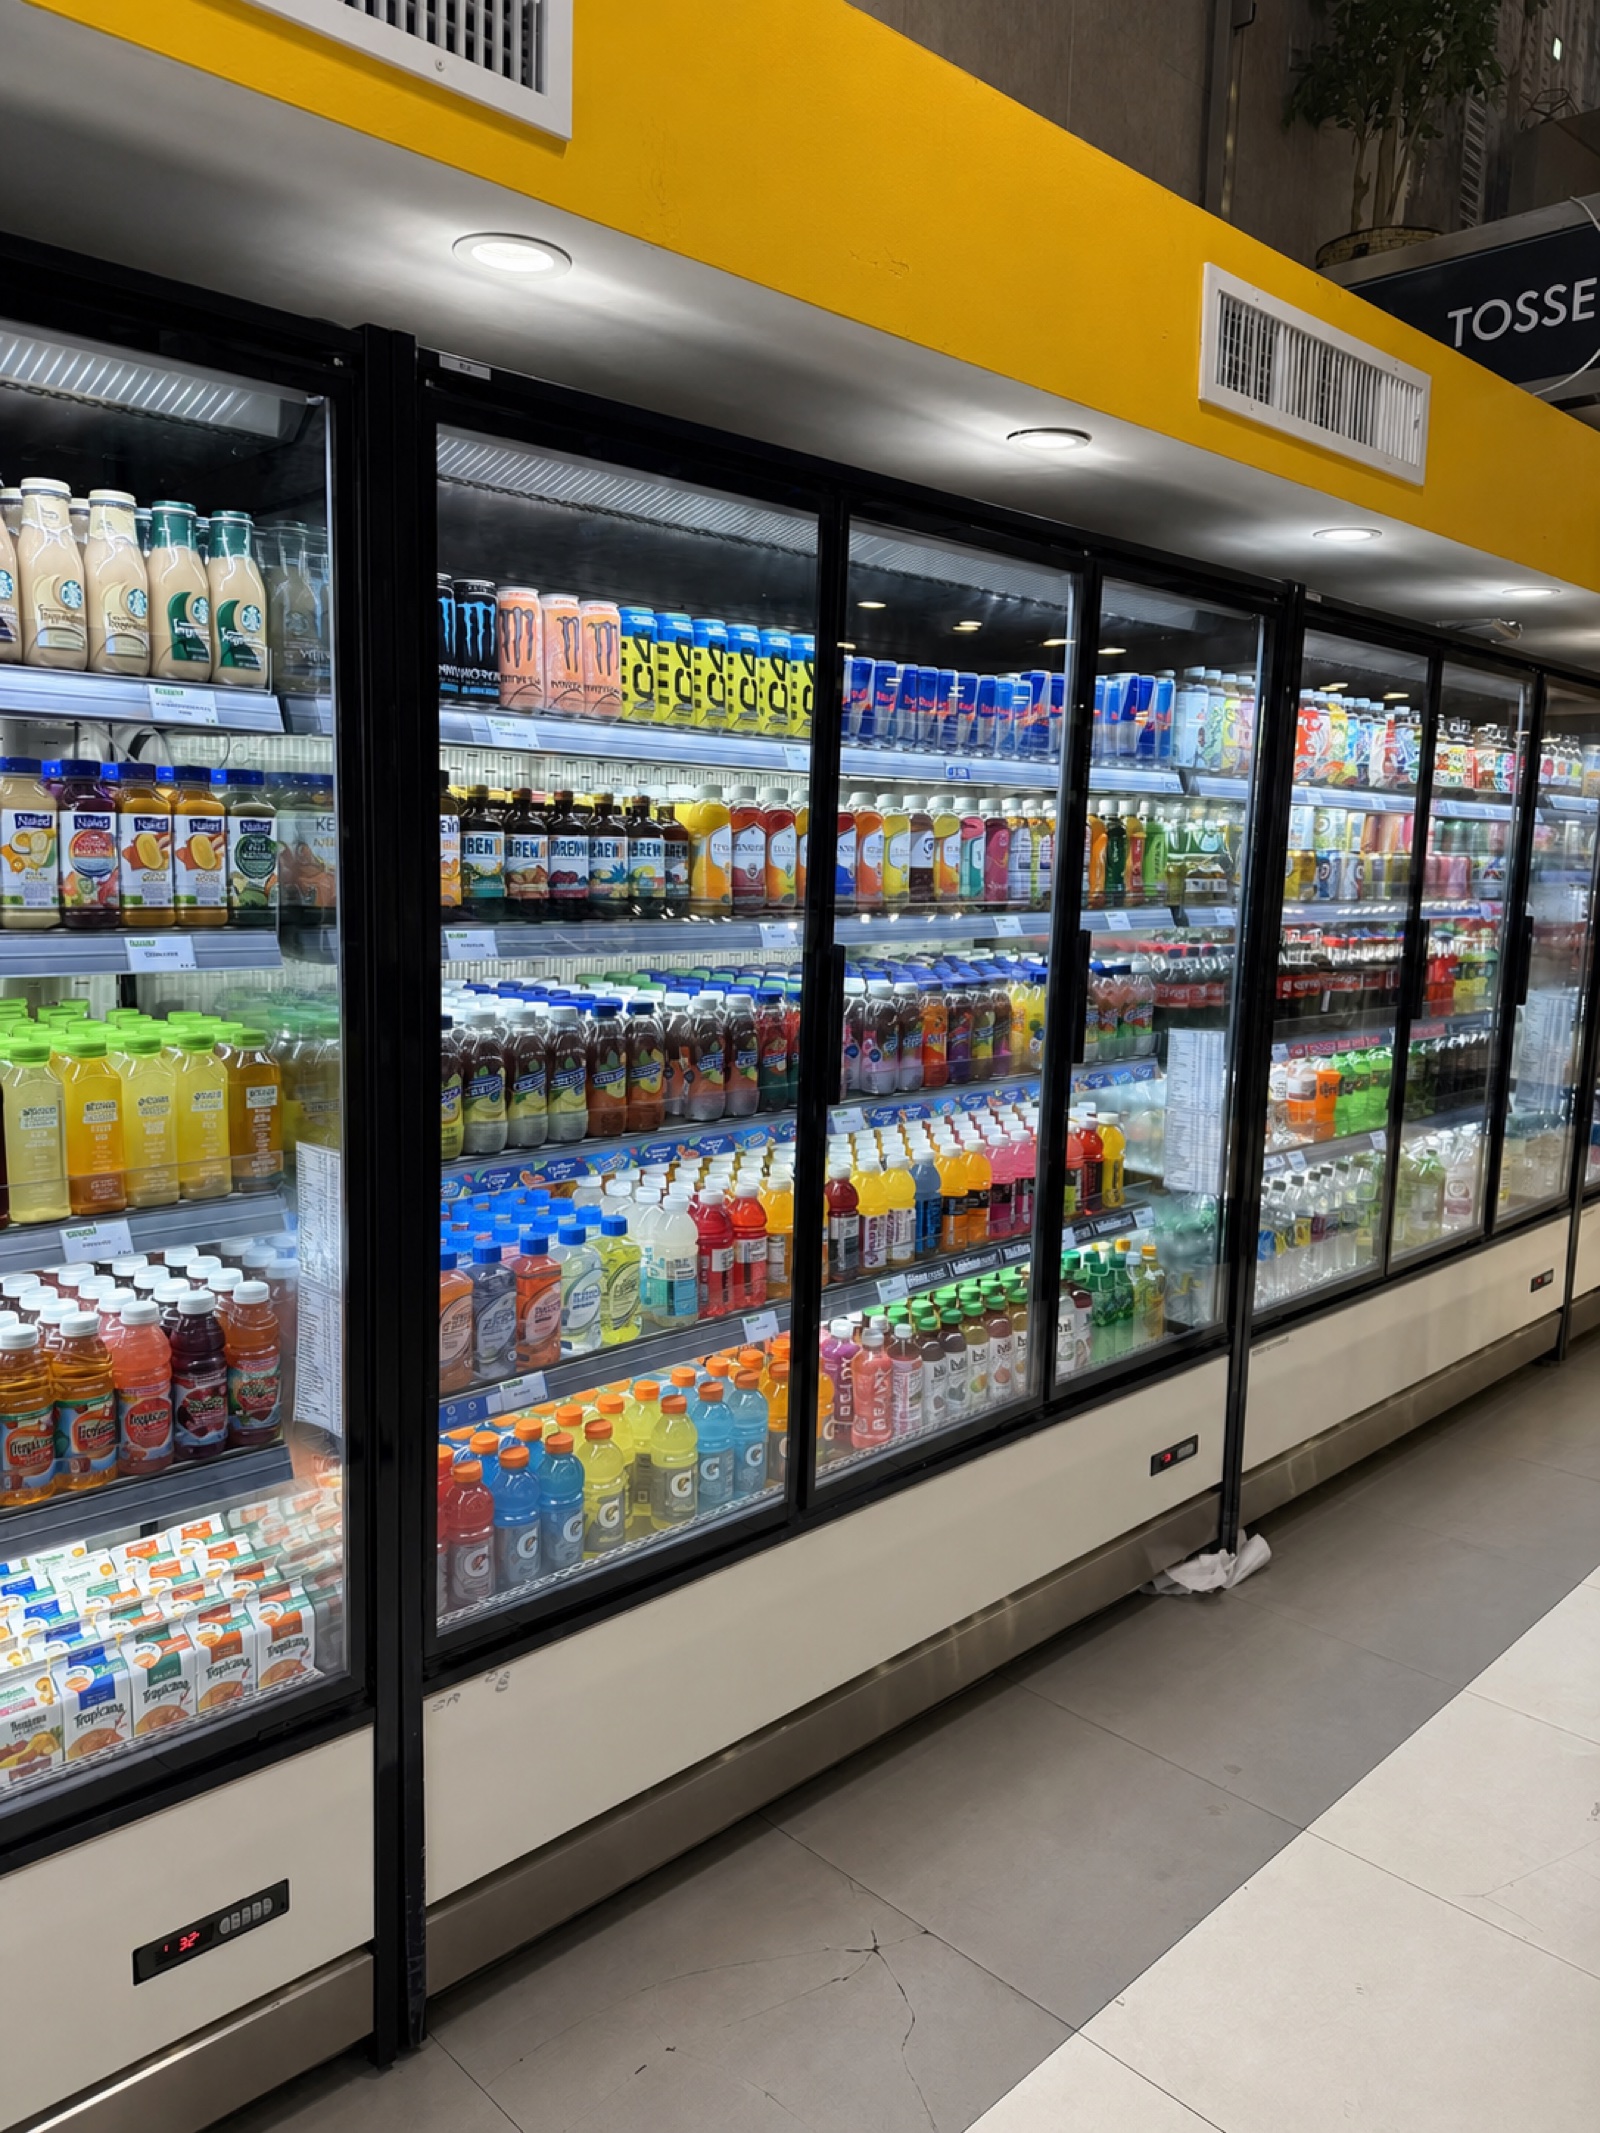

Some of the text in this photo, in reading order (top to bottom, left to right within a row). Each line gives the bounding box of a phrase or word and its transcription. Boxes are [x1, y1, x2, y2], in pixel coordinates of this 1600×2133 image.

[1447, 277, 1598, 348] TOSSE
[671, 1470, 692, 1498] G
[700, 1457, 720, 1481] G
[563, 1511, 583, 1543] G
[598, 1498, 620, 1529] G
[516, 1528, 539, 1559] G
[464, 1546, 489, 1578] G
[73, 1702, 126, 1728] Tropicana
